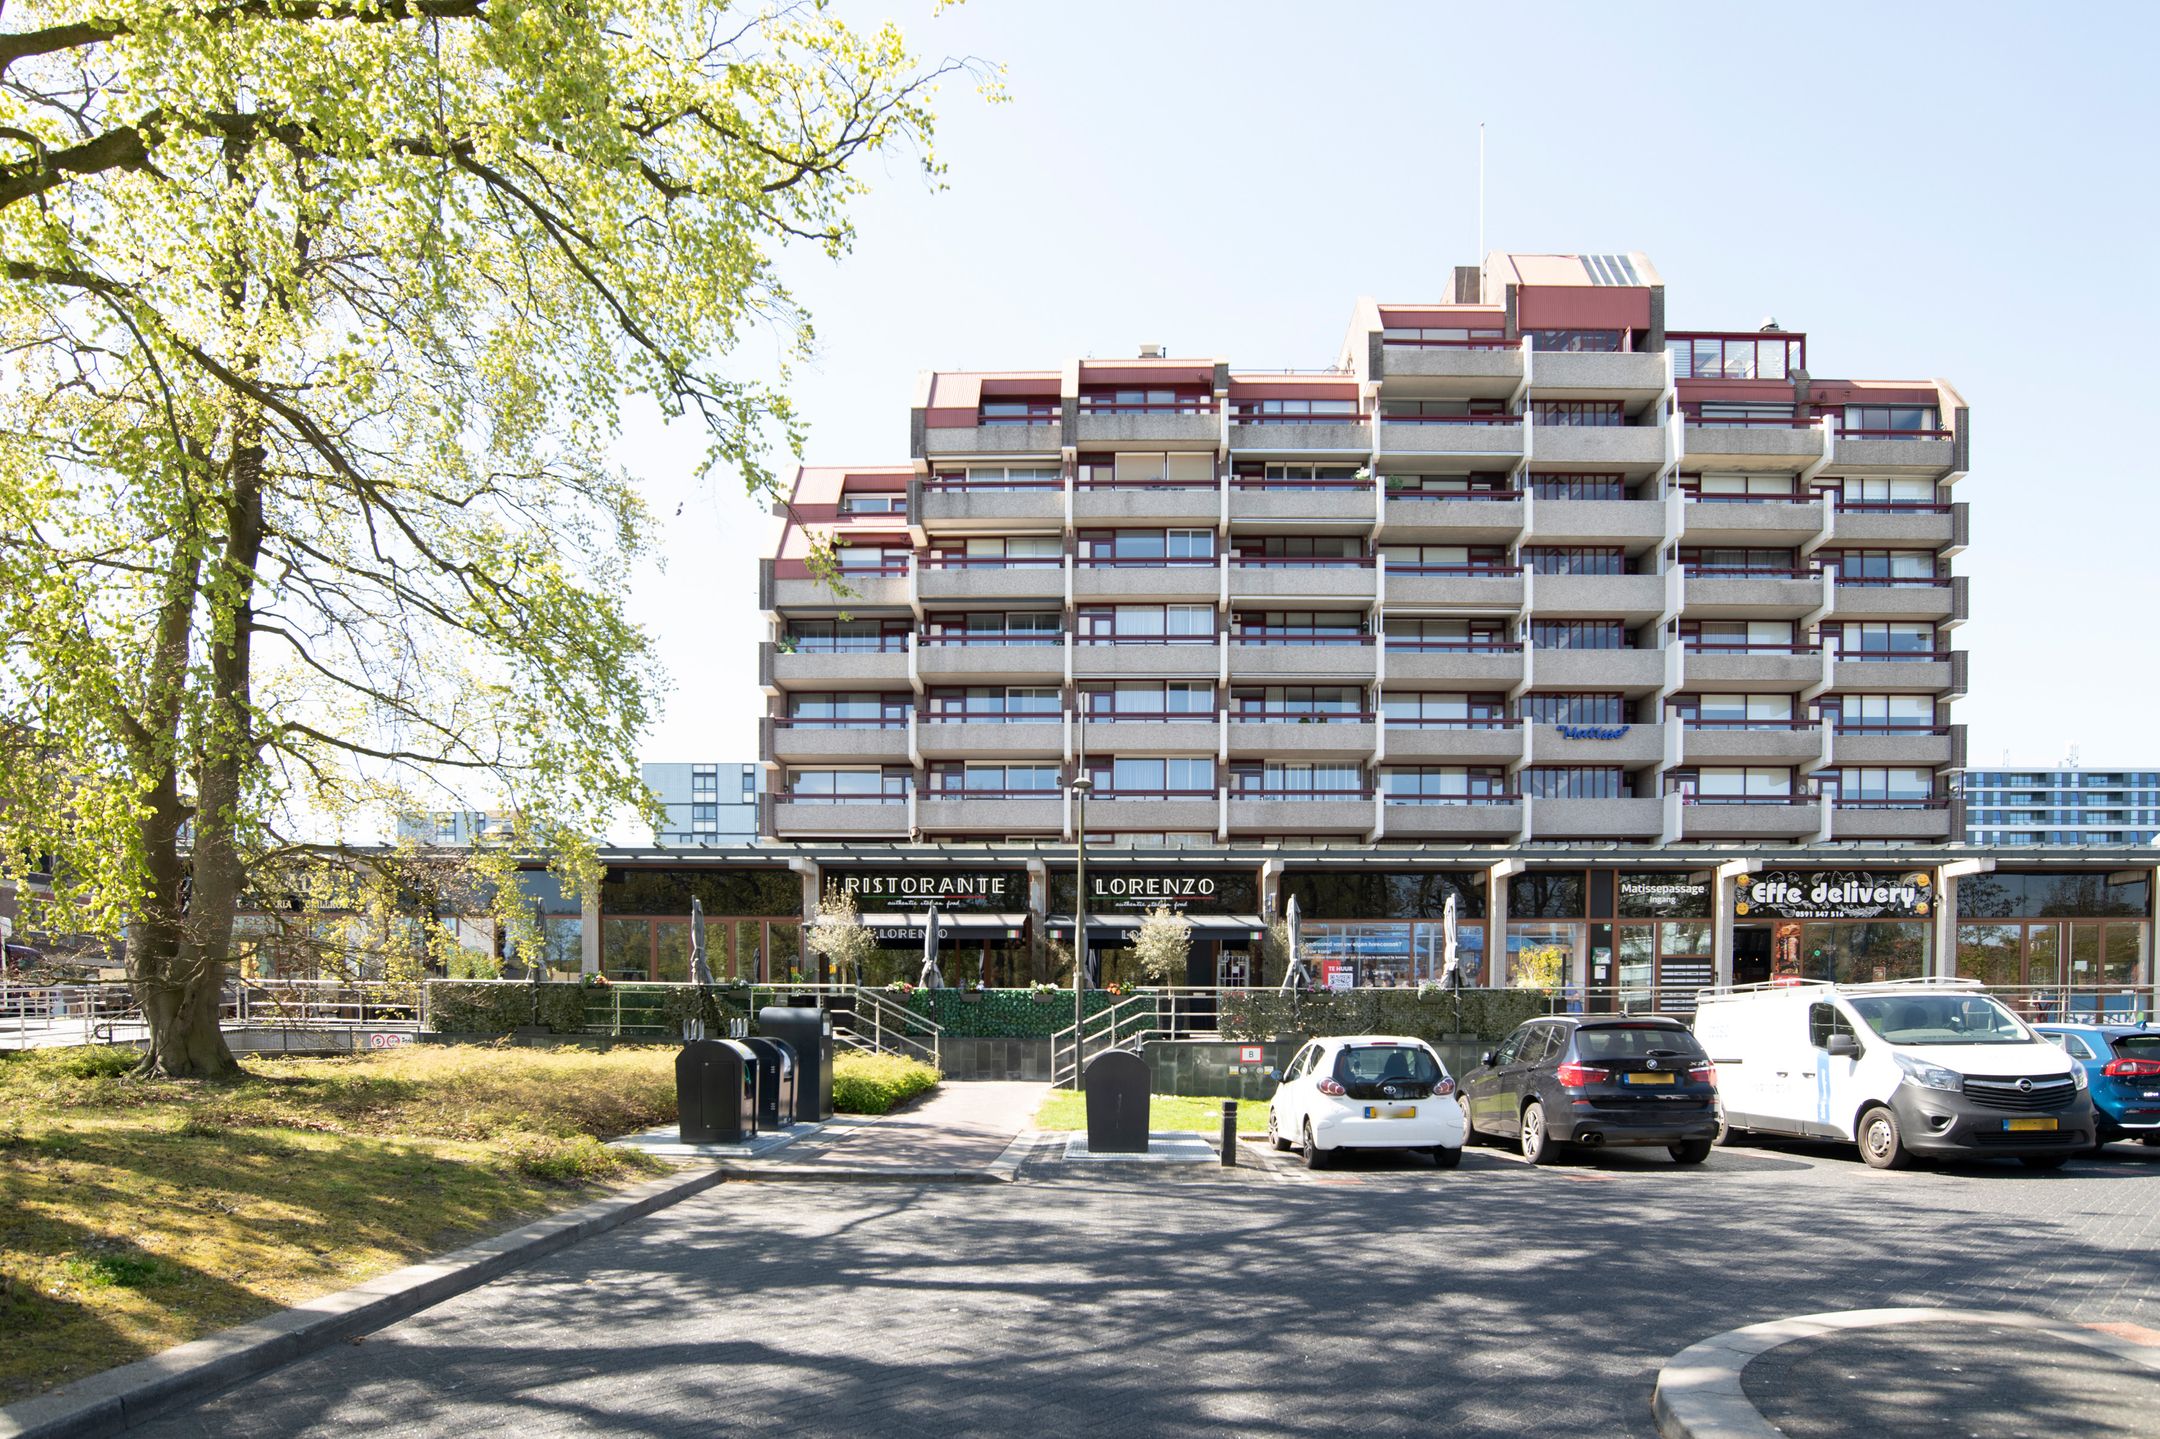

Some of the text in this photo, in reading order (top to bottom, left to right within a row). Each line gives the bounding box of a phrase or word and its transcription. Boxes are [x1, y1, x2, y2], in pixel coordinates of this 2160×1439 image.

[845, 877, 1005, 894] RISTORANTE
[1096, 878, 1215, 895] LORENZO
[1621, 884, 1705, 895] Matissepassage
[1649, 895, 1676, 904] Ingang
[1751, 880, 1916, 908] Effe delivery
[879, 929, 948, 939] LORENO
